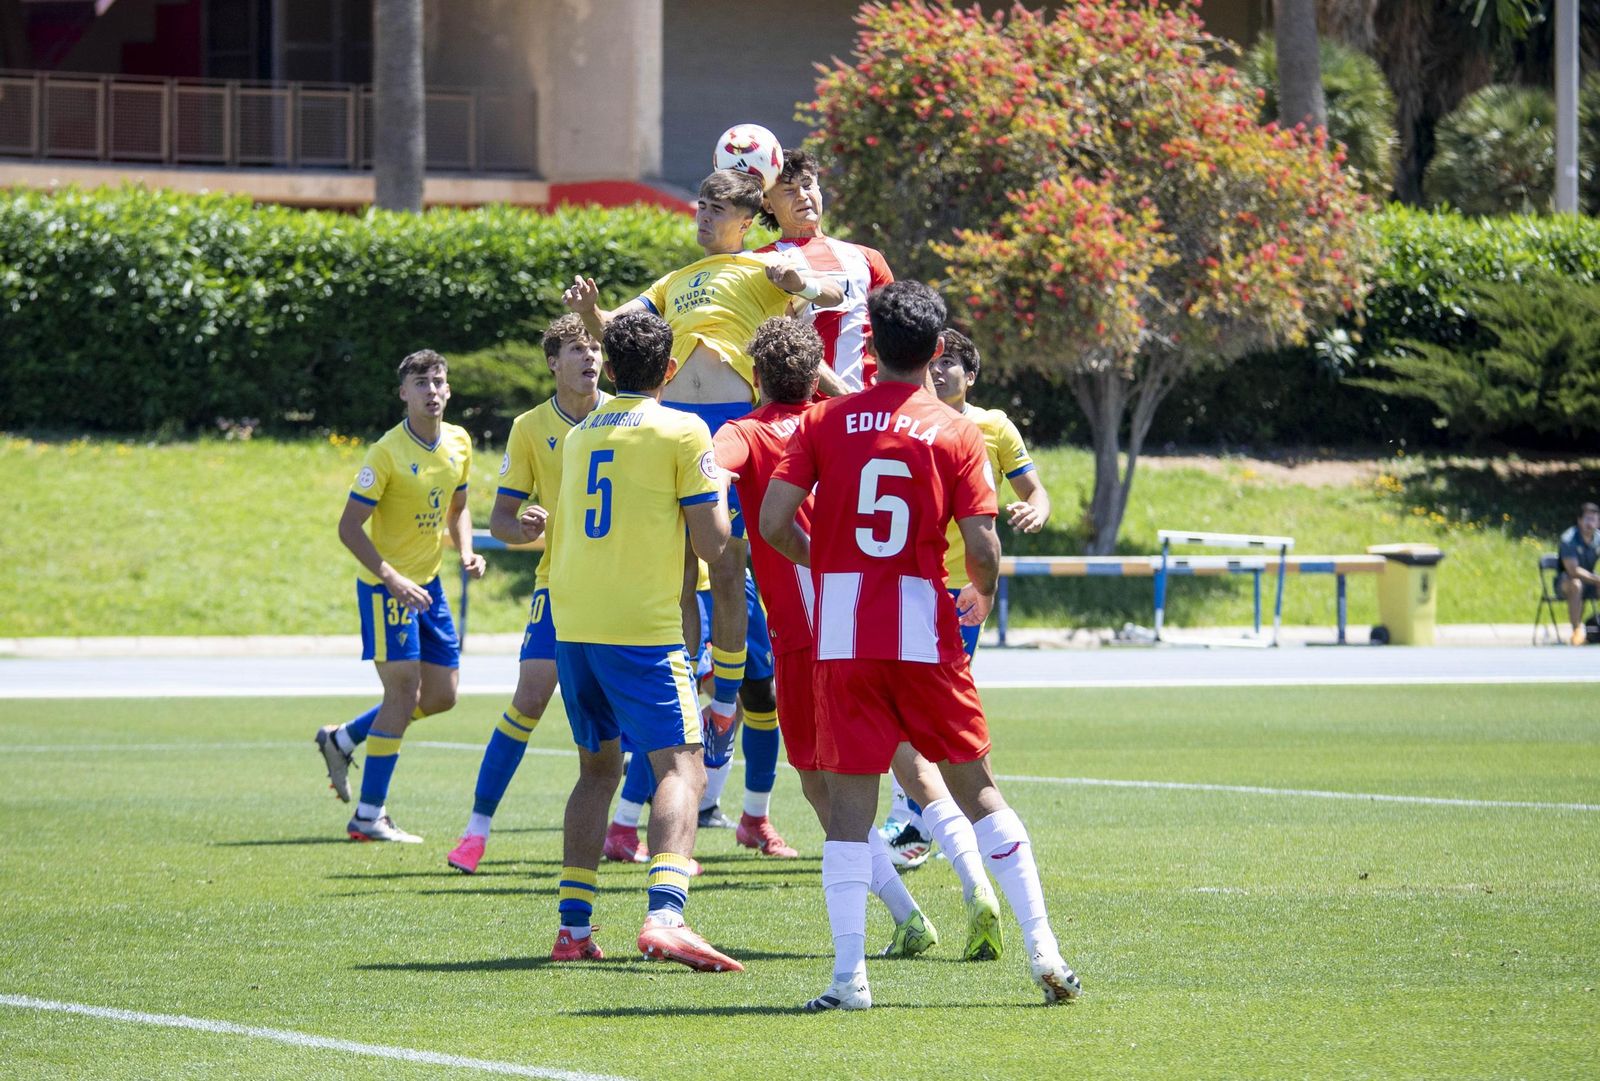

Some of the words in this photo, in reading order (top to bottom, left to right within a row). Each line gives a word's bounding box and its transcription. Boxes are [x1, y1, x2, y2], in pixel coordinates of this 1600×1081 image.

[674, 288, 707, 306] AYUDA
[676, 296, 711, 313] PYMES
[588, 411, 645, 430] ALMAGRO
[845, 411, 891, 435] EDU
[893, 414, 942, 447] PLA
[584, 448, 615, 539] 5
[854, 457, 913, 559] 5
[386, 596, 413, 626] 32
